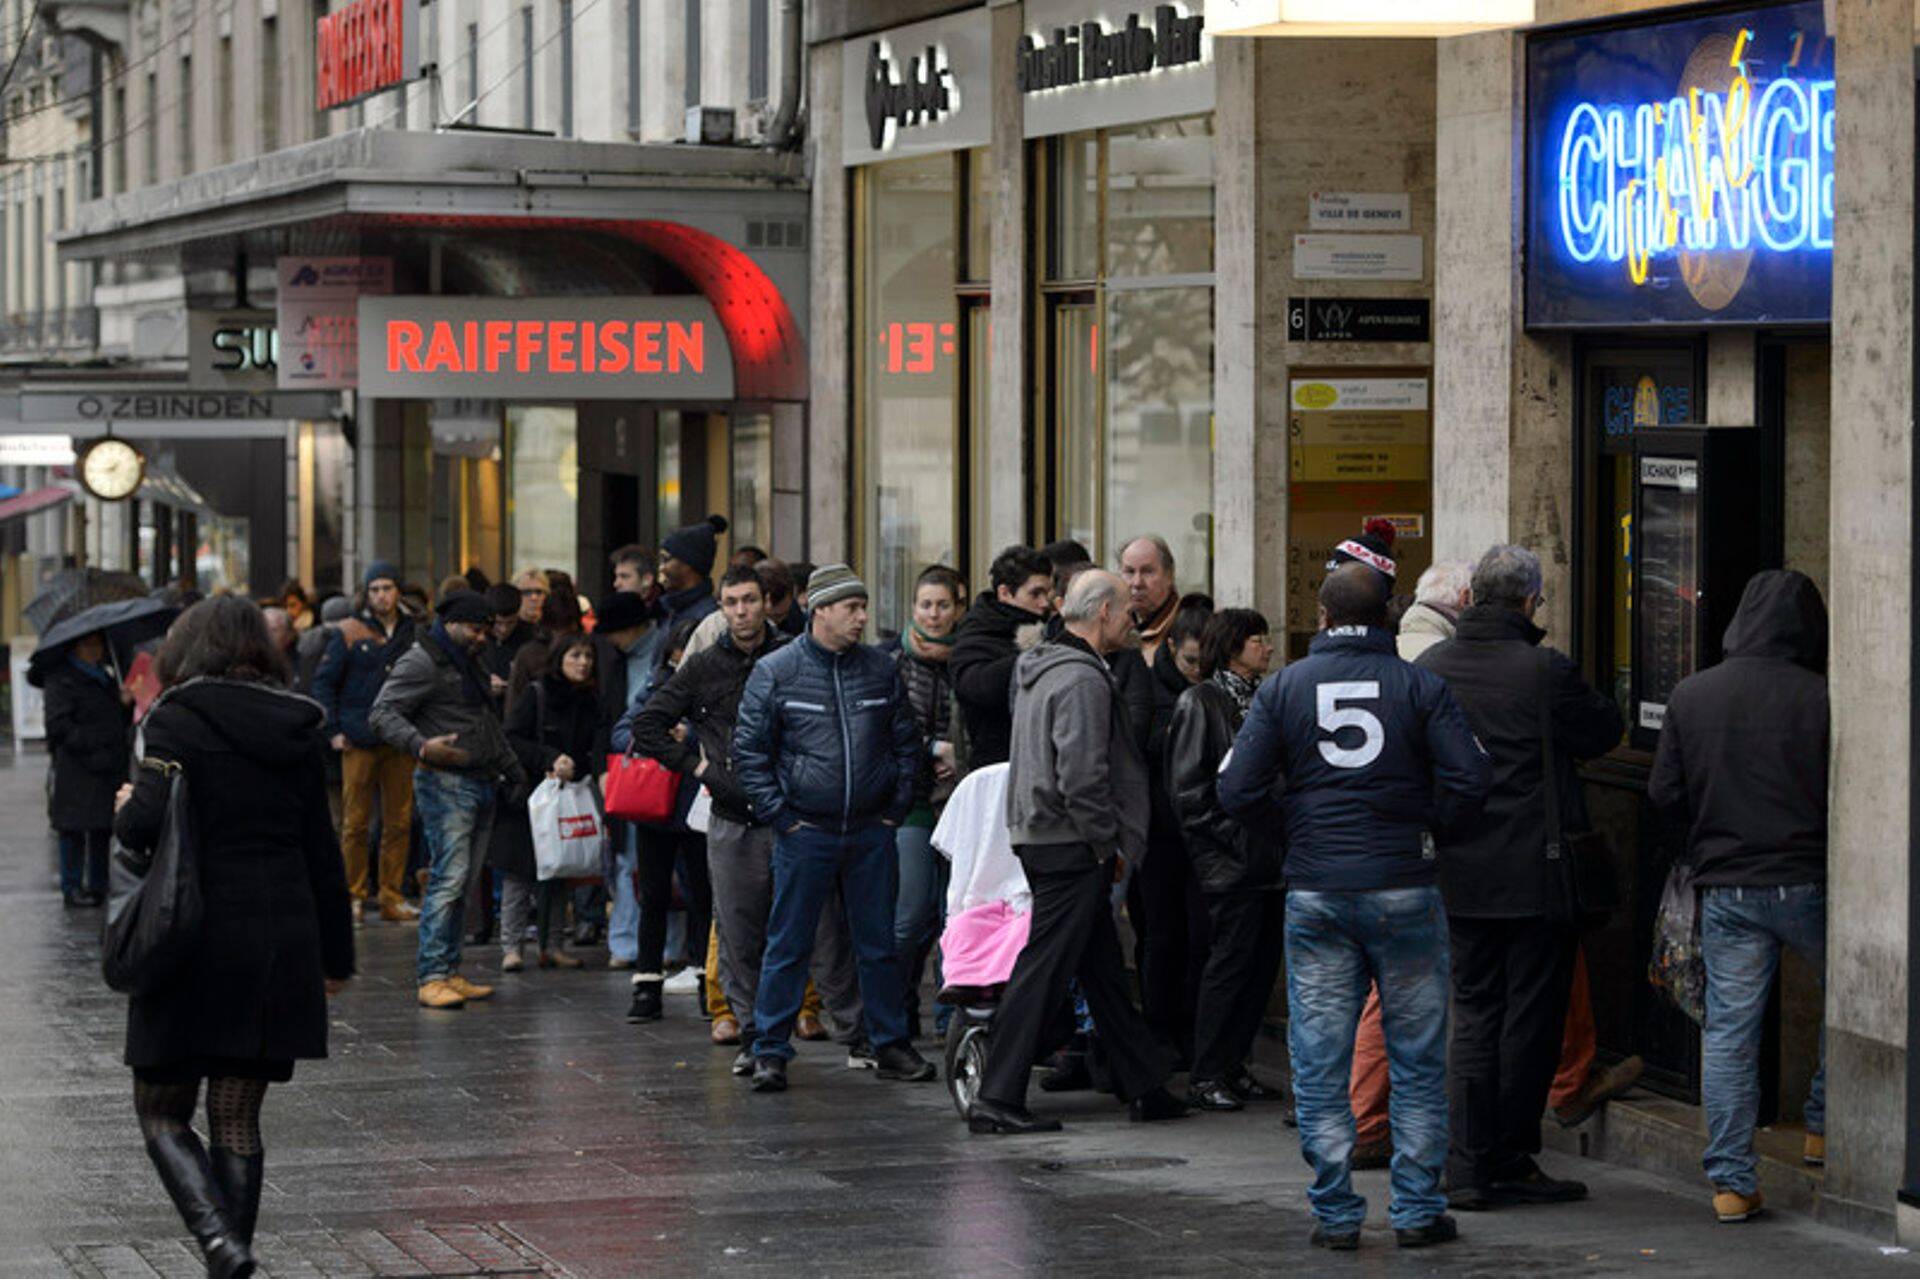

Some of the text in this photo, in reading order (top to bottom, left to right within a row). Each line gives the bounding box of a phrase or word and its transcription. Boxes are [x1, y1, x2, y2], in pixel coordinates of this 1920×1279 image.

[1291, 308, 1303, 329] 6
[387, 320, 704, 373] RAIFFEISEN
[1316, 681, 1385, 768] 5
